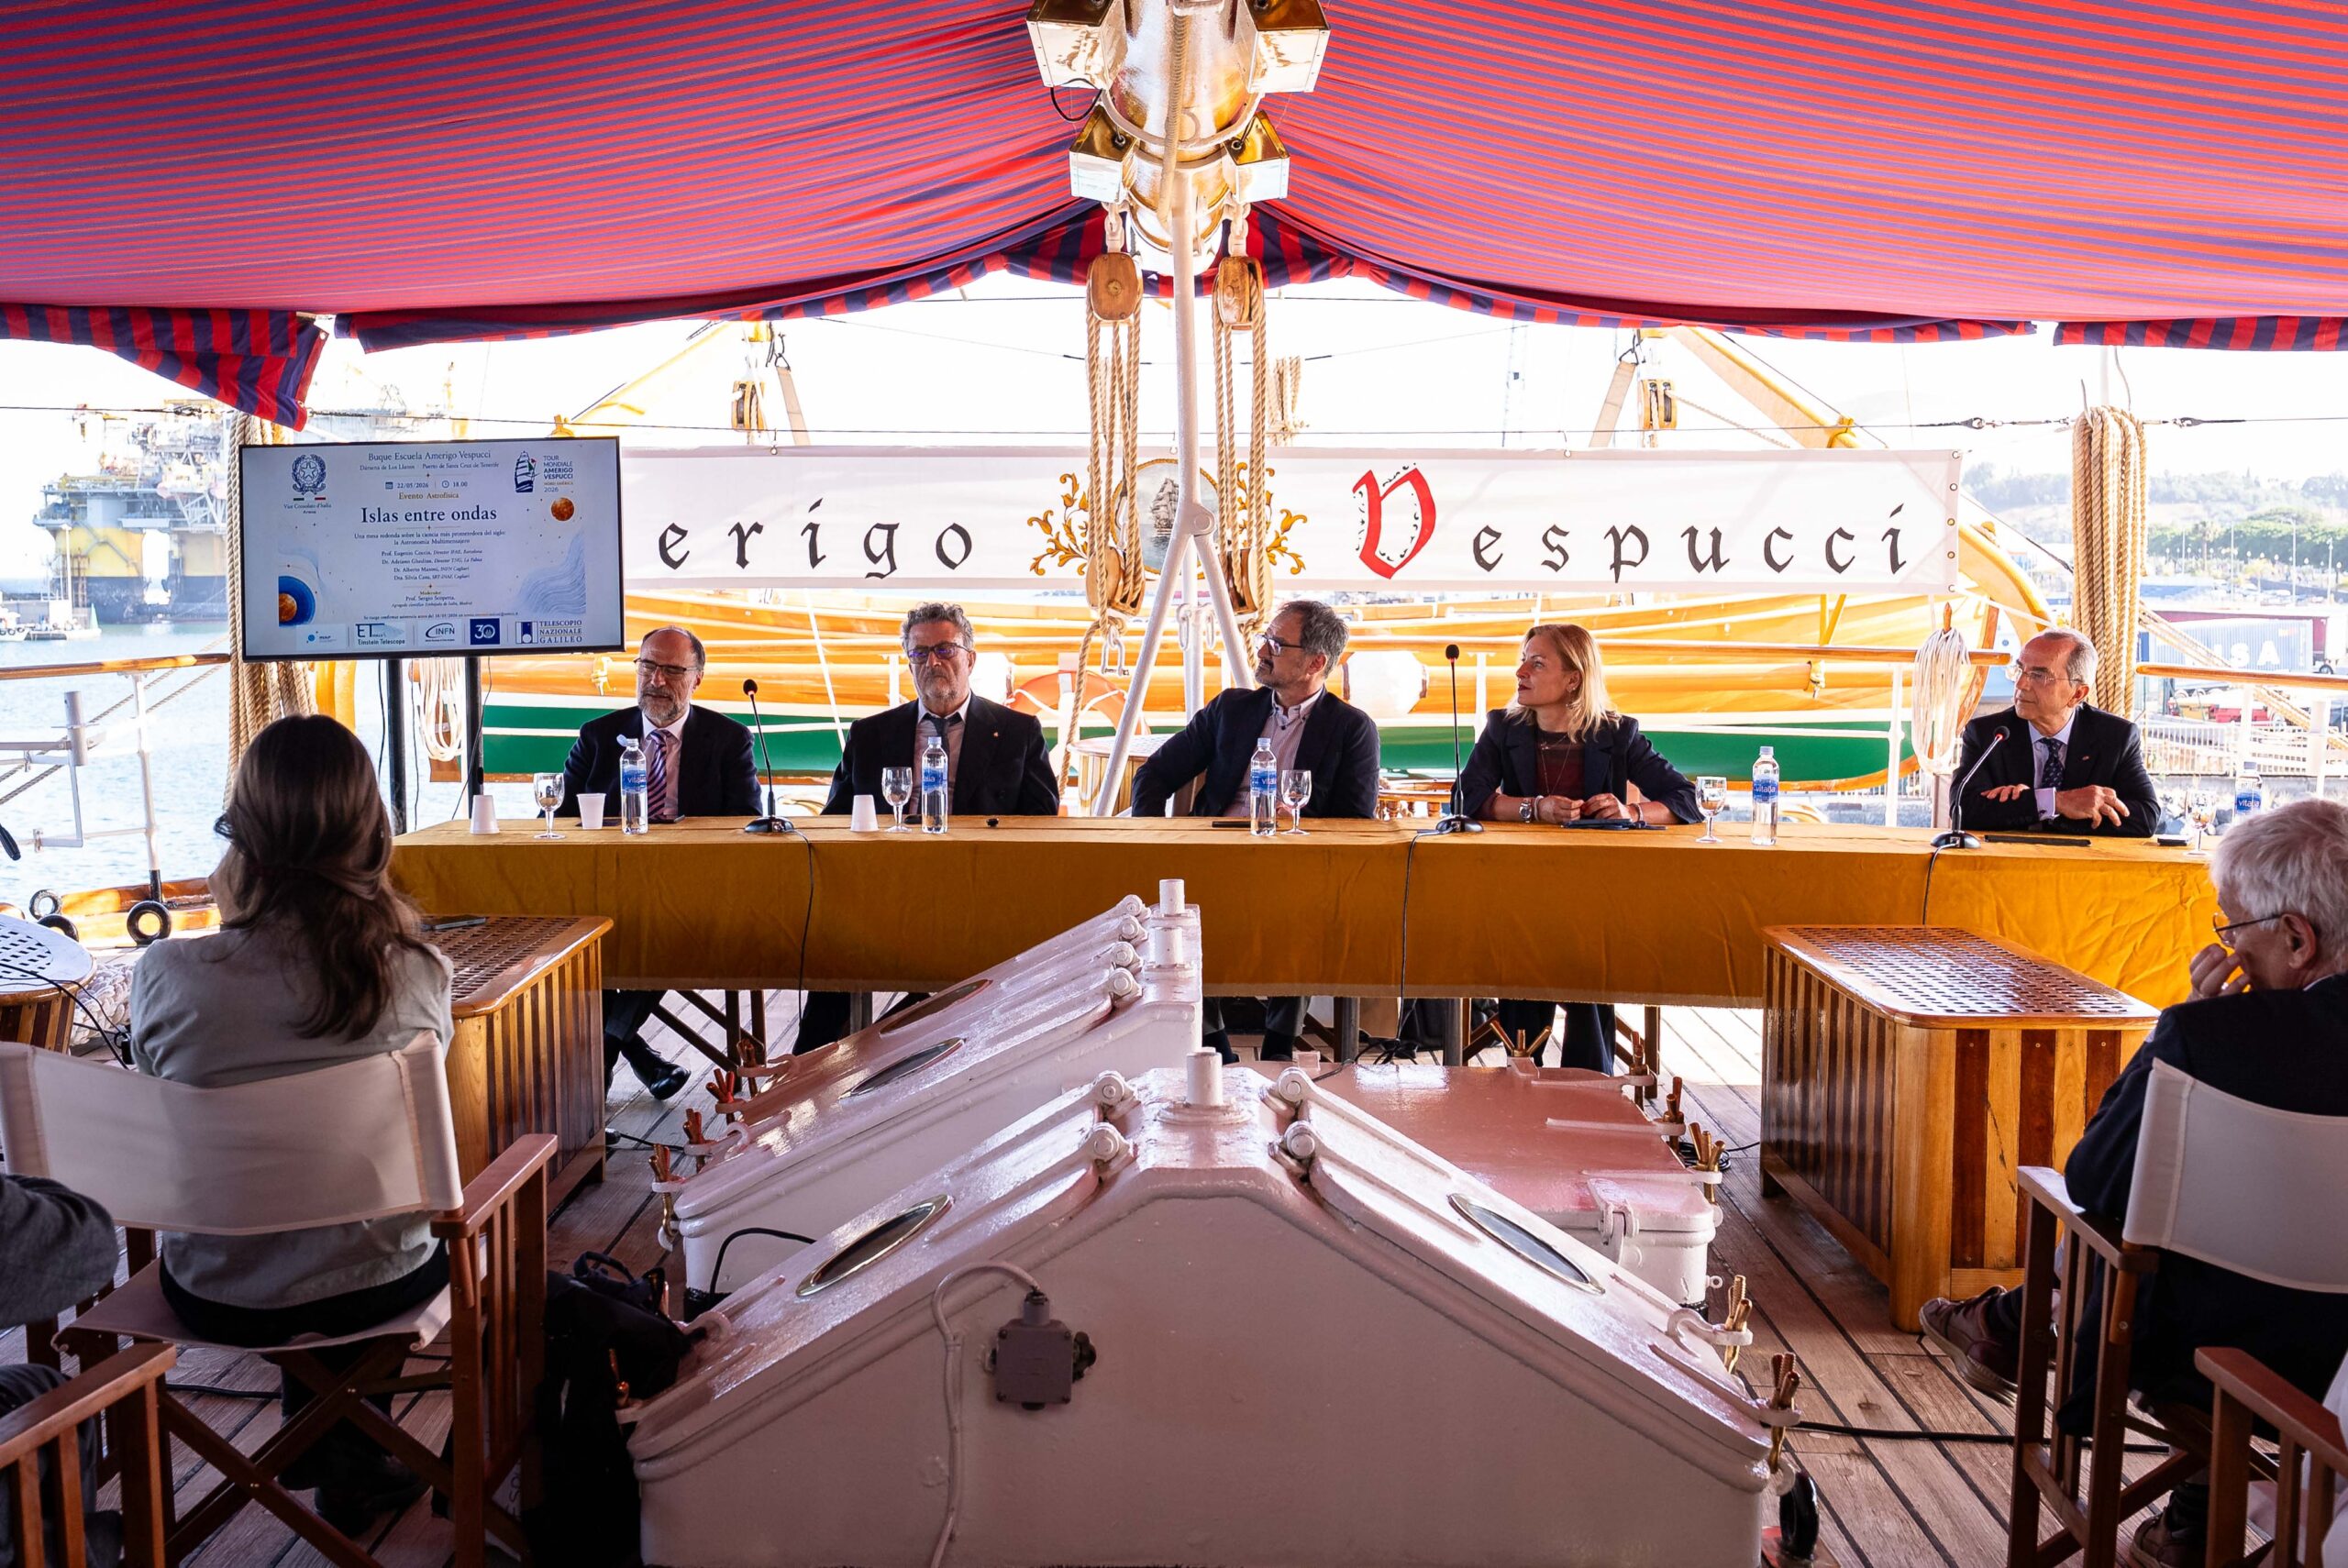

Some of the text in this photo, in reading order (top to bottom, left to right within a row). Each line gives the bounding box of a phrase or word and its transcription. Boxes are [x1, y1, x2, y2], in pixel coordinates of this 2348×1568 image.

[368, 449, 492, 463] Buque Escuela Amerigo Vespucci
[398, 491, 424, 500] Evento
[360, 504, 498, 524] Islas entre ondas
[658, 461, 1908, 584] erigo Vespucci
[539, 619, 582, 627] TELESCOPIO
[539, 627, 582, 635] NAZIONALE
[380, 637, 405, 646] Telescope
[539, 635, 582, 644] GALILEO
